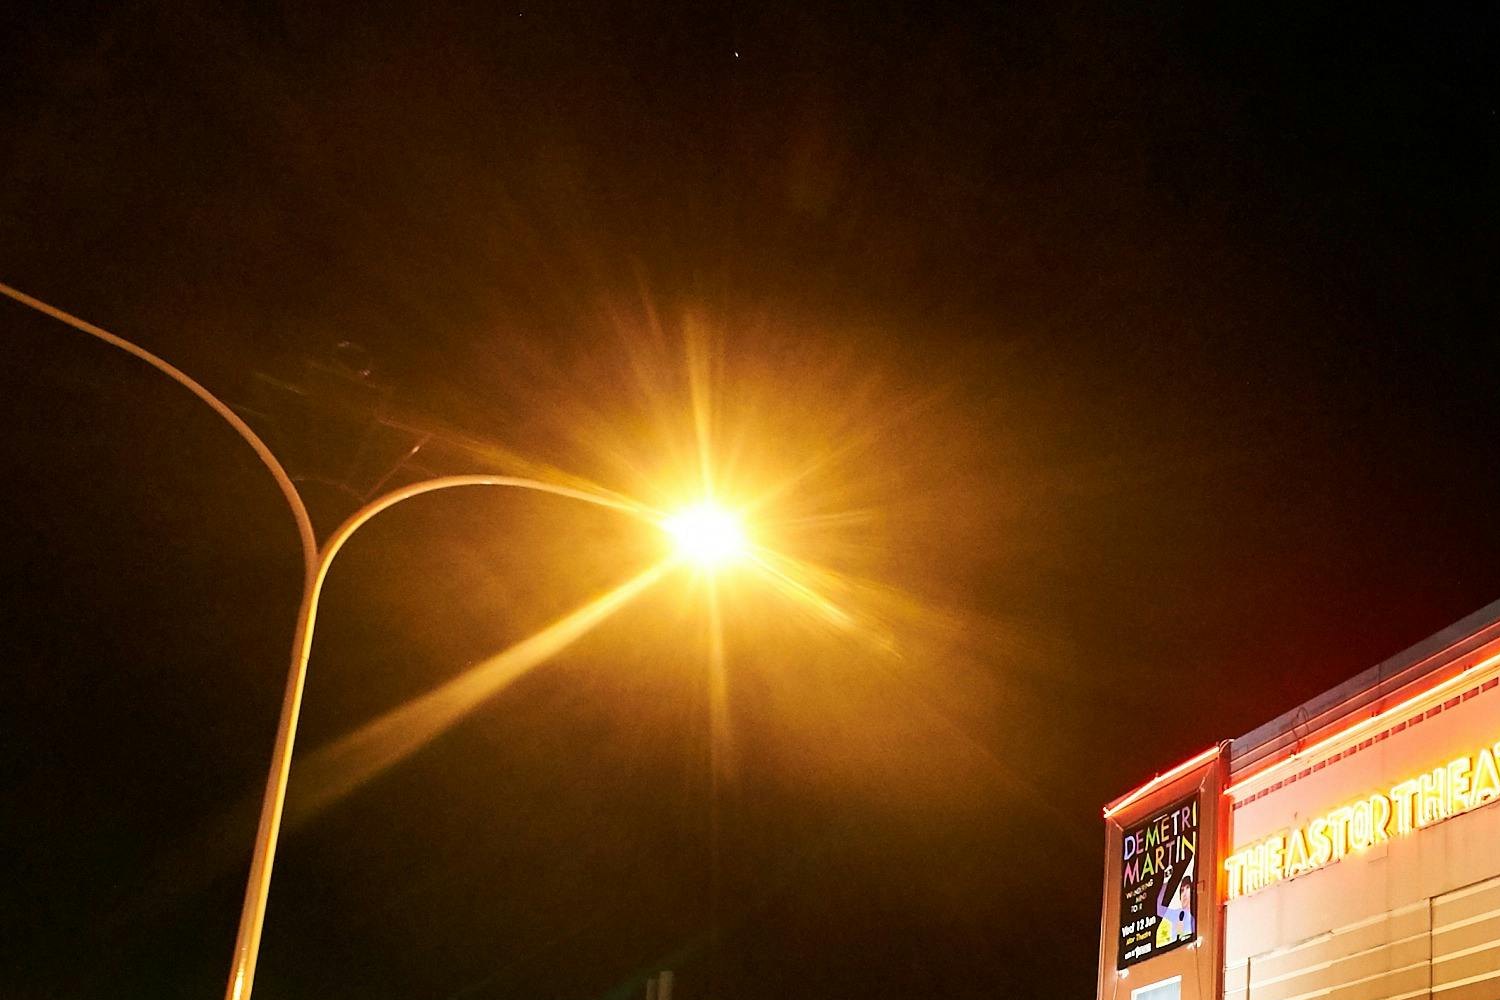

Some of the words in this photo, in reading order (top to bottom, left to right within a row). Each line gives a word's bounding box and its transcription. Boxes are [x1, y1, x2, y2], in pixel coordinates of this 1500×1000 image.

[1124, 801, 1196, 860] DEMETRI
[1124, 831, 1196, 888] MARTIN
[1224, 833, 1286, 898] THE
[1284, 794, 1393, 878] ASTOR
